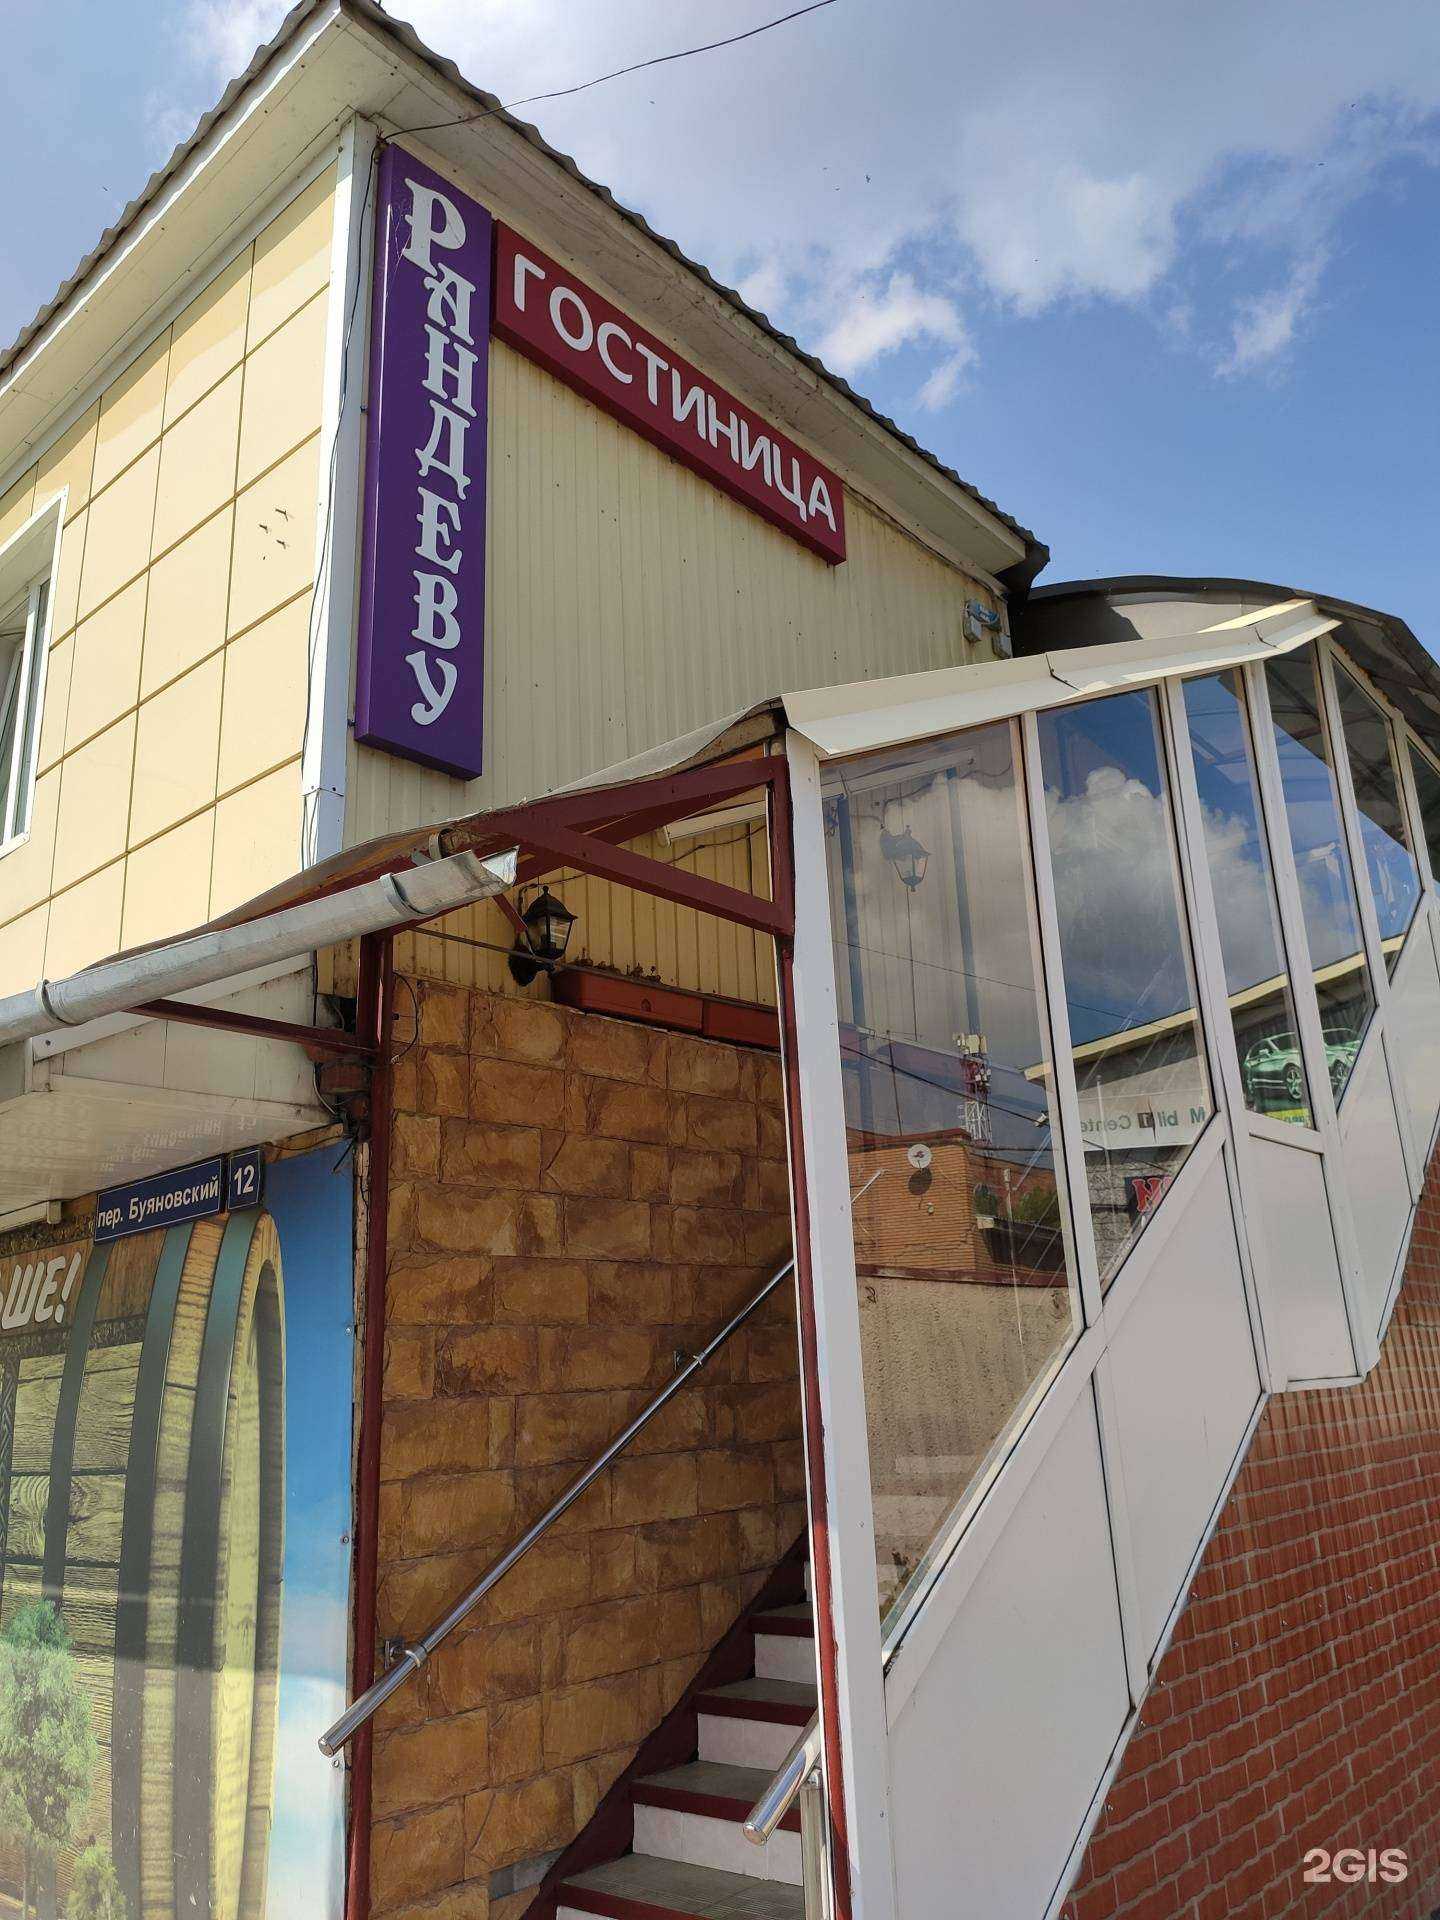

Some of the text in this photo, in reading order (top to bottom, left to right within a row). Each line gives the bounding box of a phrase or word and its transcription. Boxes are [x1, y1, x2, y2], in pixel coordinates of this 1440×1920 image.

[402, 177, 478, 727] РАНДЕВУ
[513, 253, 838, 533] ГОСТИНИЦА
[97, 1164, 255, 1229] пер. Буяновский 12
[0, 1251, 82, 1330] ШЕ!
